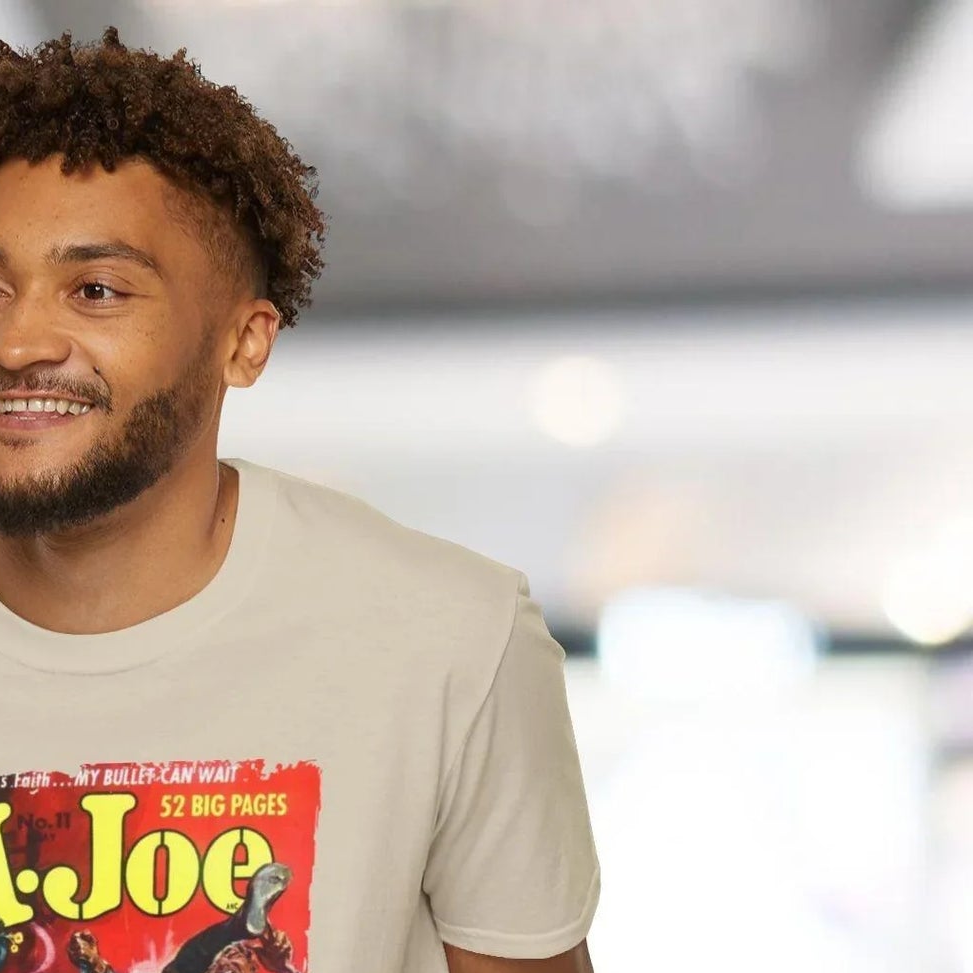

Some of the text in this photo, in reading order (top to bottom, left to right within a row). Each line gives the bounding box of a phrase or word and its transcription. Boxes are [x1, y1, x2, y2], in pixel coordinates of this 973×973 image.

[103, 768, 155, 786] BULLET
[160, 767, 195, 785] CAN
[160, 793, 288, 818] 52 BIG PAGES
